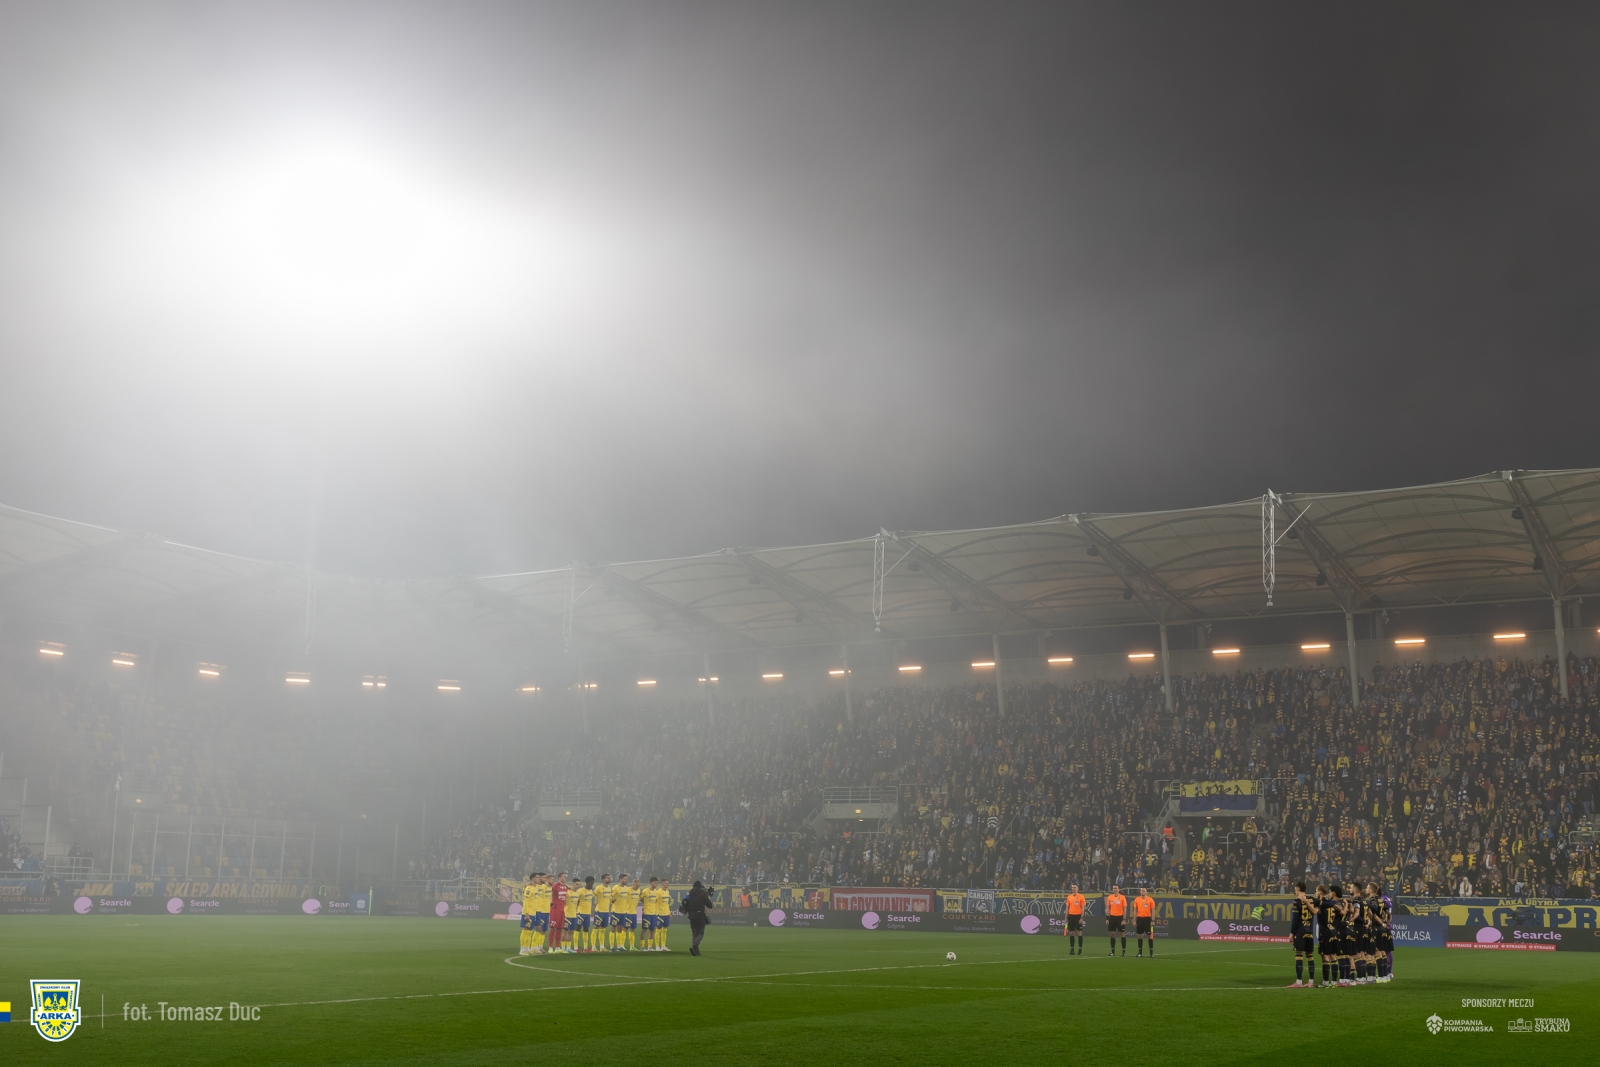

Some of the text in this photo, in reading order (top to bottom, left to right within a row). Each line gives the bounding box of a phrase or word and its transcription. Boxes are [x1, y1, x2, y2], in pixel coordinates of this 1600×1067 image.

[968, 892, 994, 901] CARLOS
[454, 903, 479, 911] Searcle
[850, 896, 911, 912] GDYNIANIE
[793, 912, 825, 920] Searcle
[887, 914, 921, 923] Searcle
[1229, 923, 1270, 932] Searcle
[1513, 930, 1562, 940] Searcle
